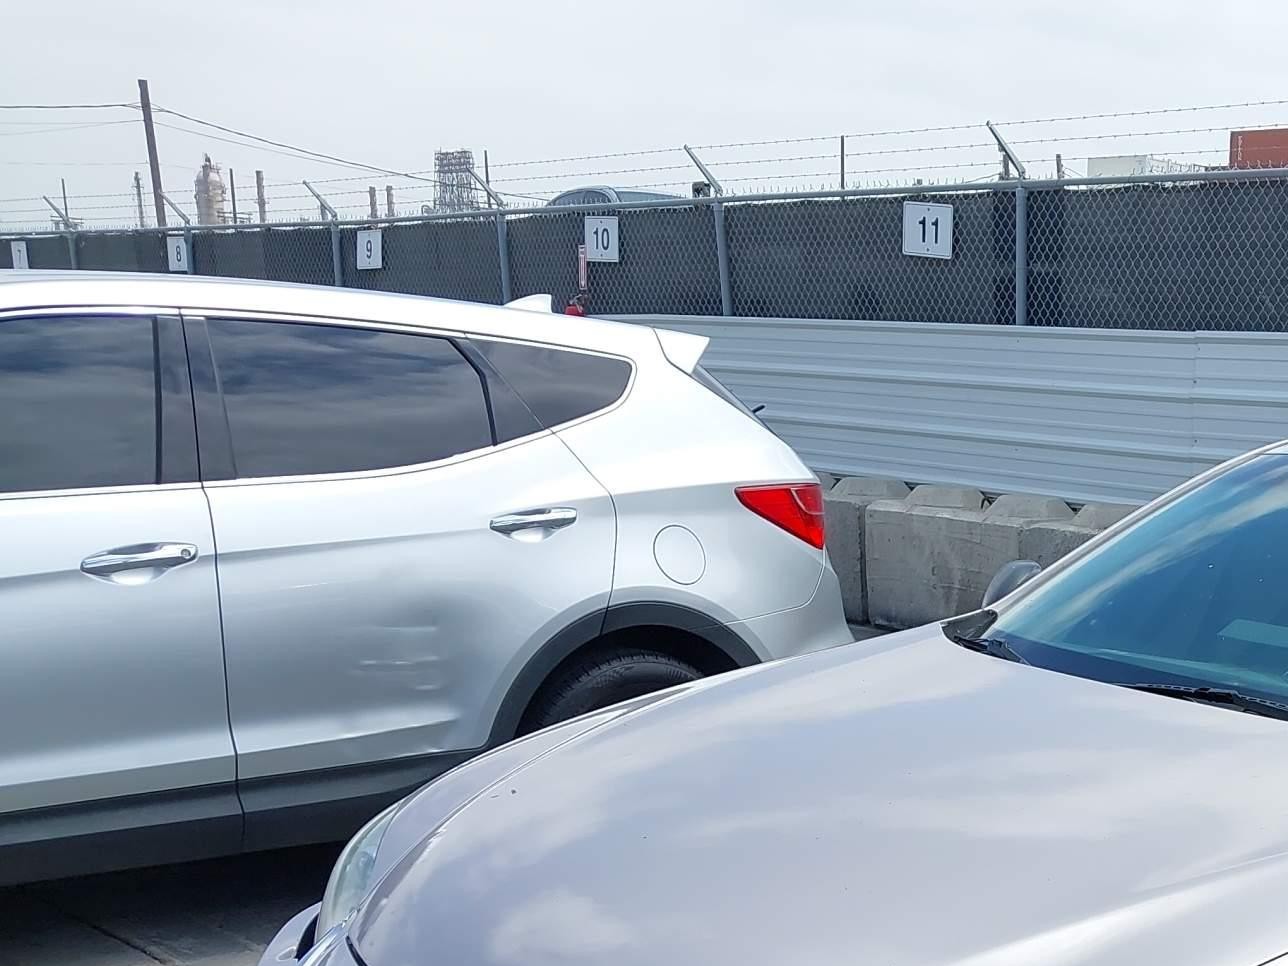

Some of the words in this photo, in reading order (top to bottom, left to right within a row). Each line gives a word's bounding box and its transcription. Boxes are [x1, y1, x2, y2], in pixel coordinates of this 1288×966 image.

[593, 227, 610, 250] 10
[918, 216, 939, 244] 11
[175, 245, 182, 262] 8
[365, 239, 373, 259] 9
